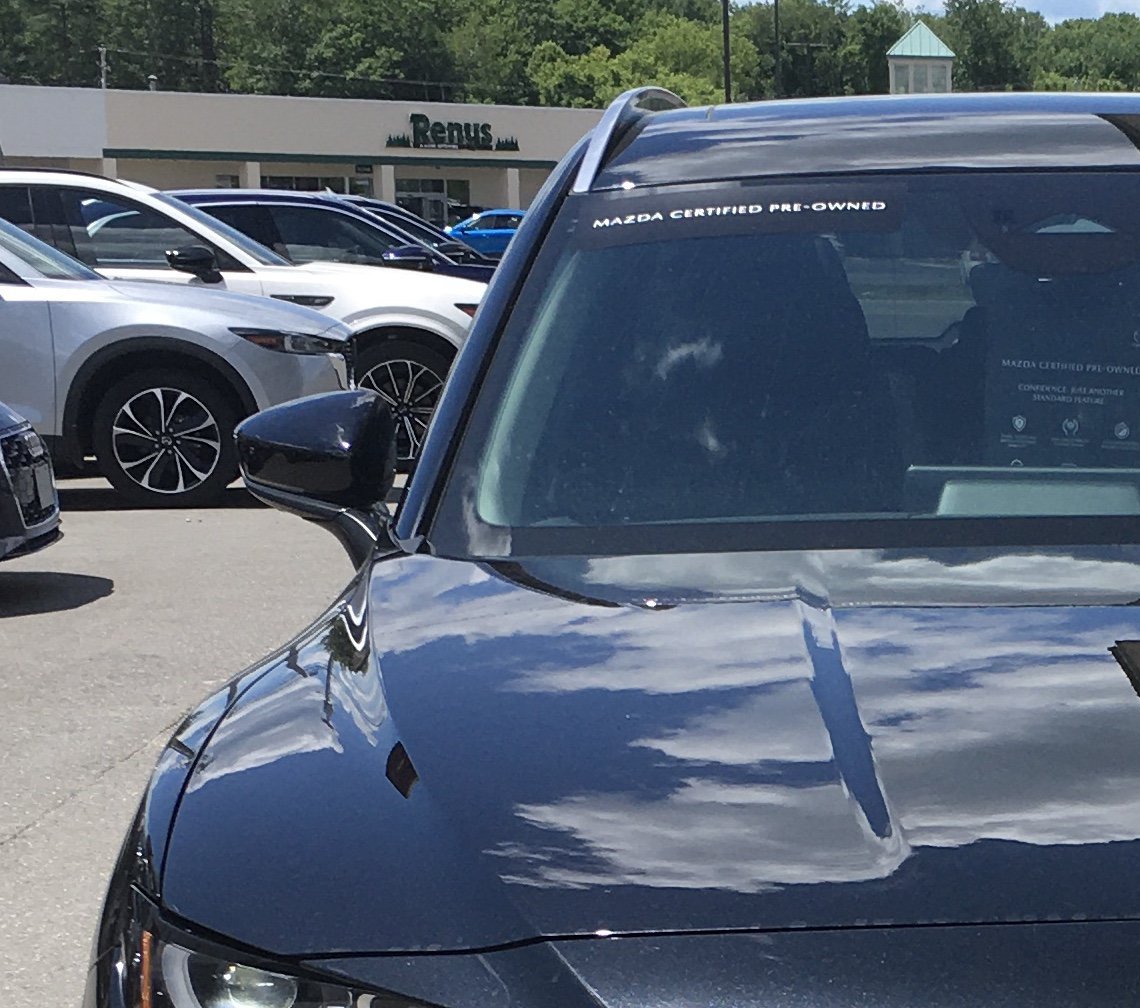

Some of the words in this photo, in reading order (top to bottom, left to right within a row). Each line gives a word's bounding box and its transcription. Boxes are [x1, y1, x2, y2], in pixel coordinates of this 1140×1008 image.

[592, 212, 664, 228] MAZDA
[669, 204, 763, 220] CERTIFIED
[769, 201, 887, 213] PRE-OWNED
[1001, 359, 1037, 369] MAZDA
[1039, 362, 1084, 373] CERTIFIED
